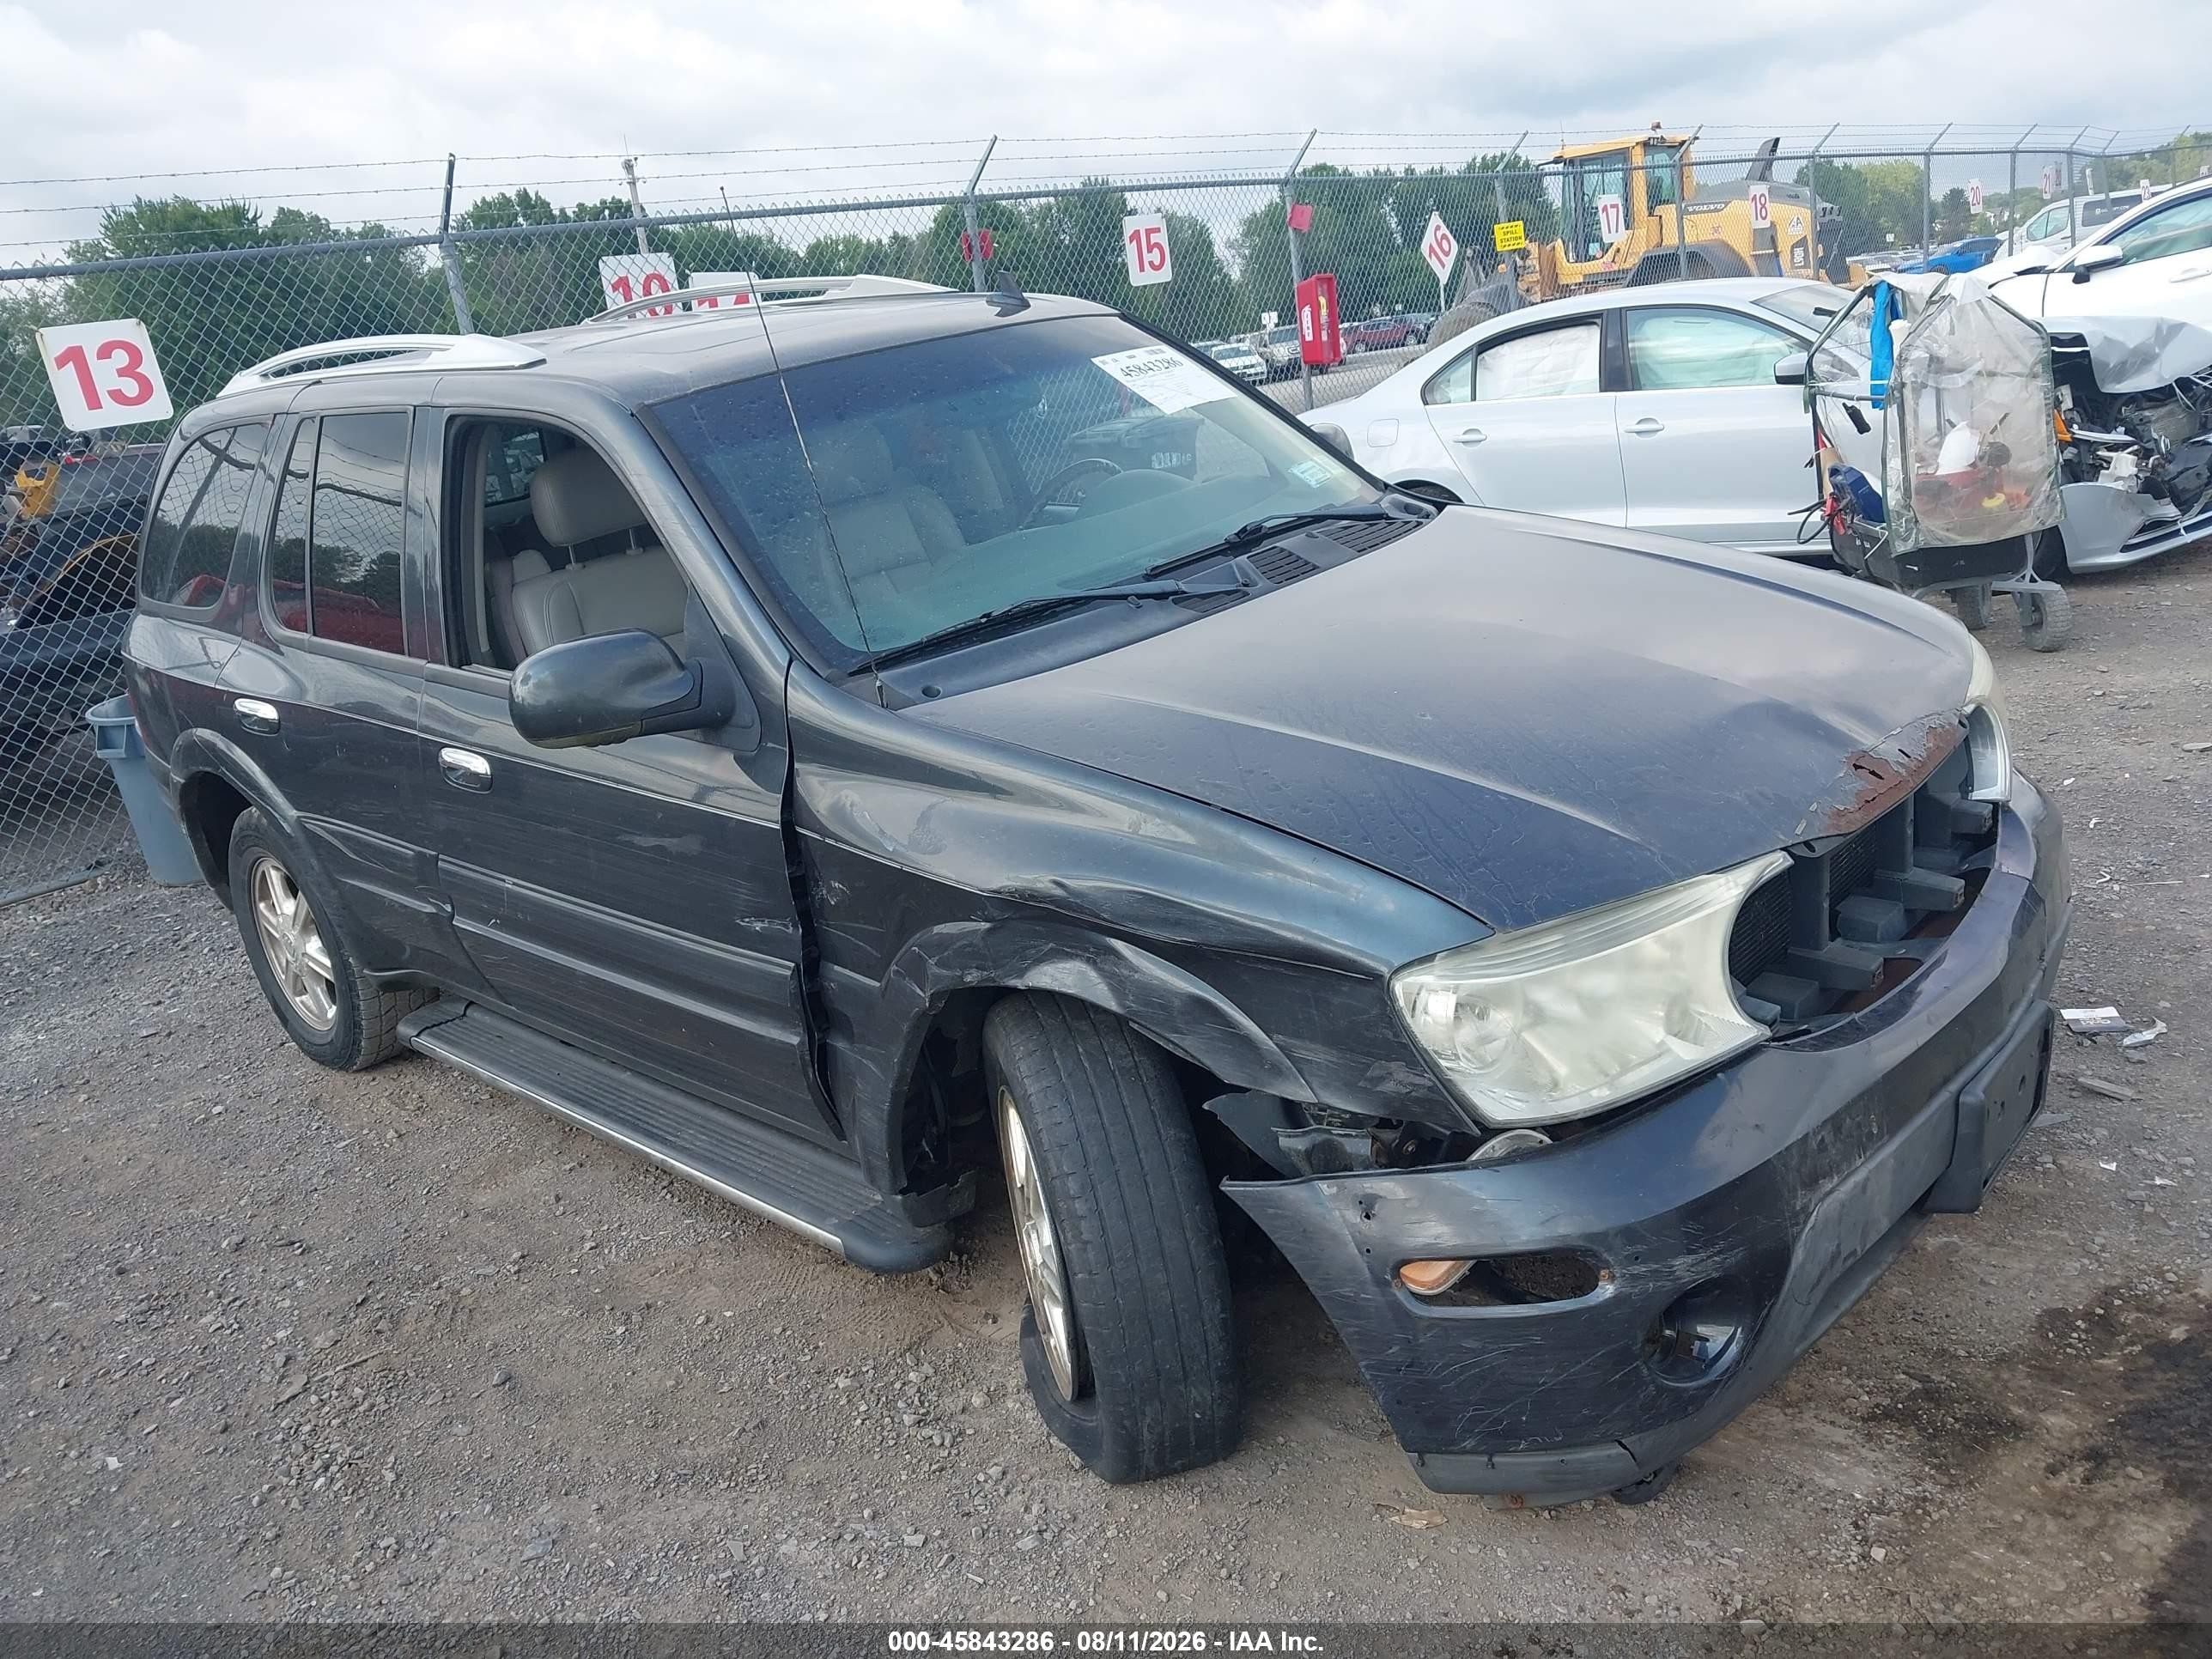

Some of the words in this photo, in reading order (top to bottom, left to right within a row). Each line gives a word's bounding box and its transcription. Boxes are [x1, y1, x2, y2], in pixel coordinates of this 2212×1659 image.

[1971, 185, 1981, 207] 20
[2044, 173, 2051, 194] 21
[1601, 204, 1620, 234] 17
[1687, 204, 1725, 212] VOLVO
[1751, 193, 1768, 222] 18
[1499, 234, 1522, 244] STATION
[1503, 228, 1519, 237] SPILL
[1129, 227, 1166, 273] 15
[1428, 224, 1452, 270] 16
[611, 272, 674, 319] 10
[53, 339, 155, 411] 13
[1120, 356, 1184, 378] 45843286
